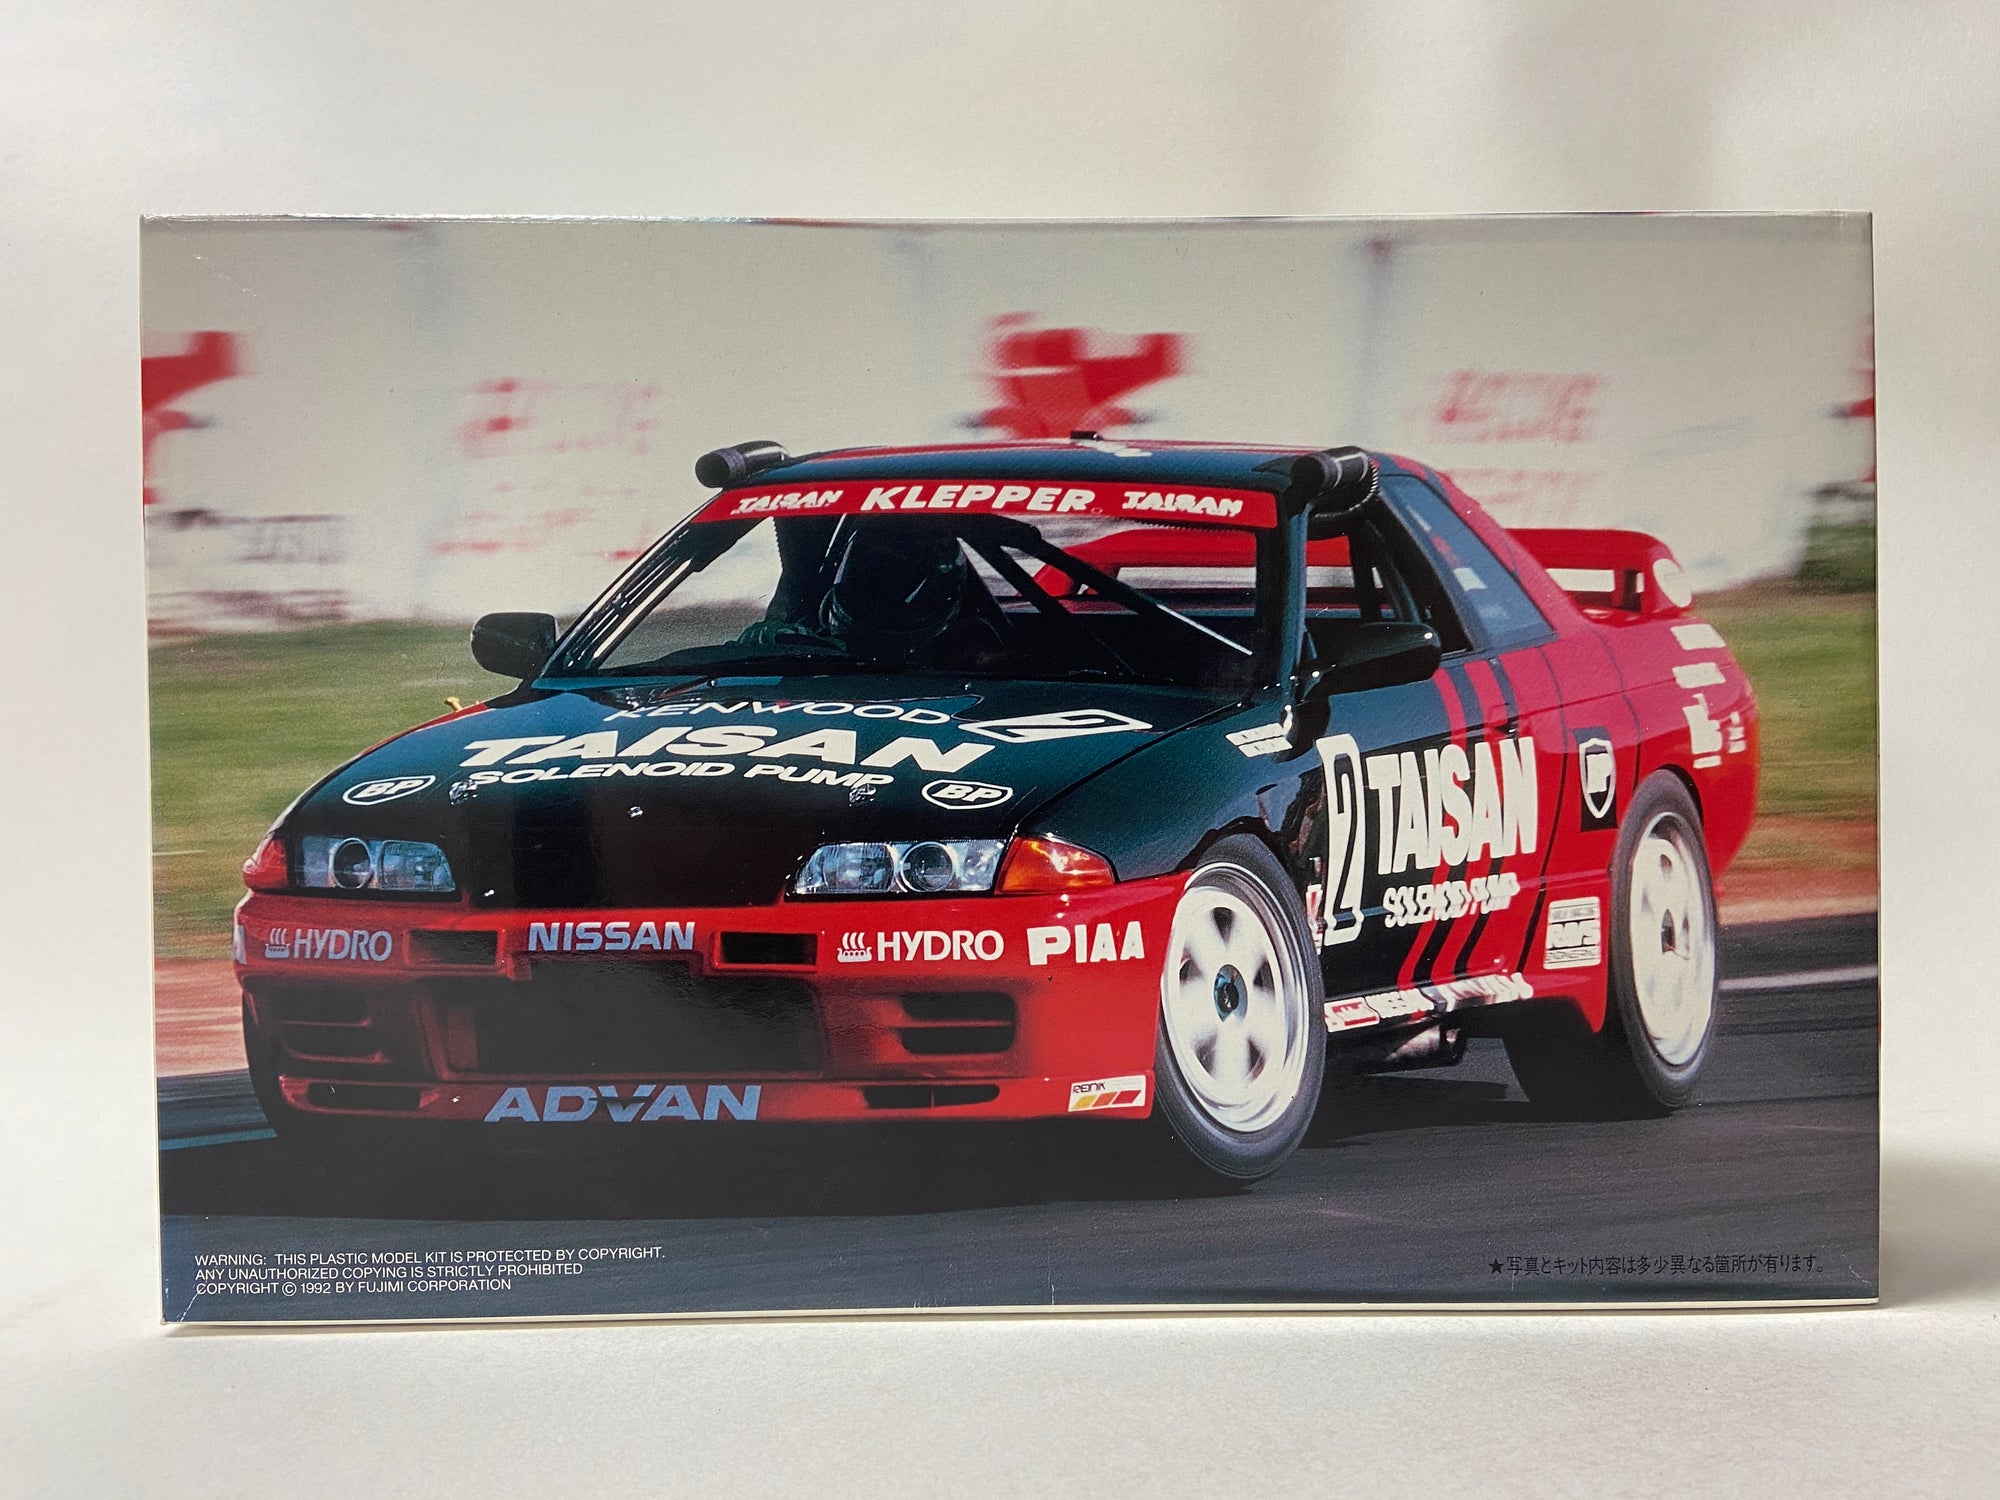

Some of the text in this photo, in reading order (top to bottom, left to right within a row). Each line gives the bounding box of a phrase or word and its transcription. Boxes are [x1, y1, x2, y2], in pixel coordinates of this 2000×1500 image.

[731, 484, 1243, 517] TAISAN KLEPPER TAISAN
[604, 701, 951, 724] KENWOOD
[459, 725, 995, 773] TAISAN
[355, 779, 424, 799] BP
[469, 761, 895, 788] SOLENOID PUMP
[933, 784, 1003, 802] BP
[1366, 736, 1538, 875] TAISAN
[294, 929, 392, 962] HYDRO
[528, 921, 695, 951] NISSAN
[877, 930, 1005, 961] HYDRO
[1027, 921, 1145, 966] PIAA
[484, 1085, 761, 1122] ADVAN
[195, 1247, 666, 1266] WARNING: THIS PLASTIC MODEL KIT IS PROTECTED BY COPYRIGHT.
[196, 1263, 583, 1280] ANY UNAUTHORIZED COPYING IS STRICTLY PROHIBITED
[196, 1282, 279, 1295] COPYRIGHT
[301, 1282, 331, 1293] 1992
[336, 1281, 354, 1293] BY
[359, 1280, 403, 1292] FUJIMI
[407, 1279, 511, 1292] CORPORATION
